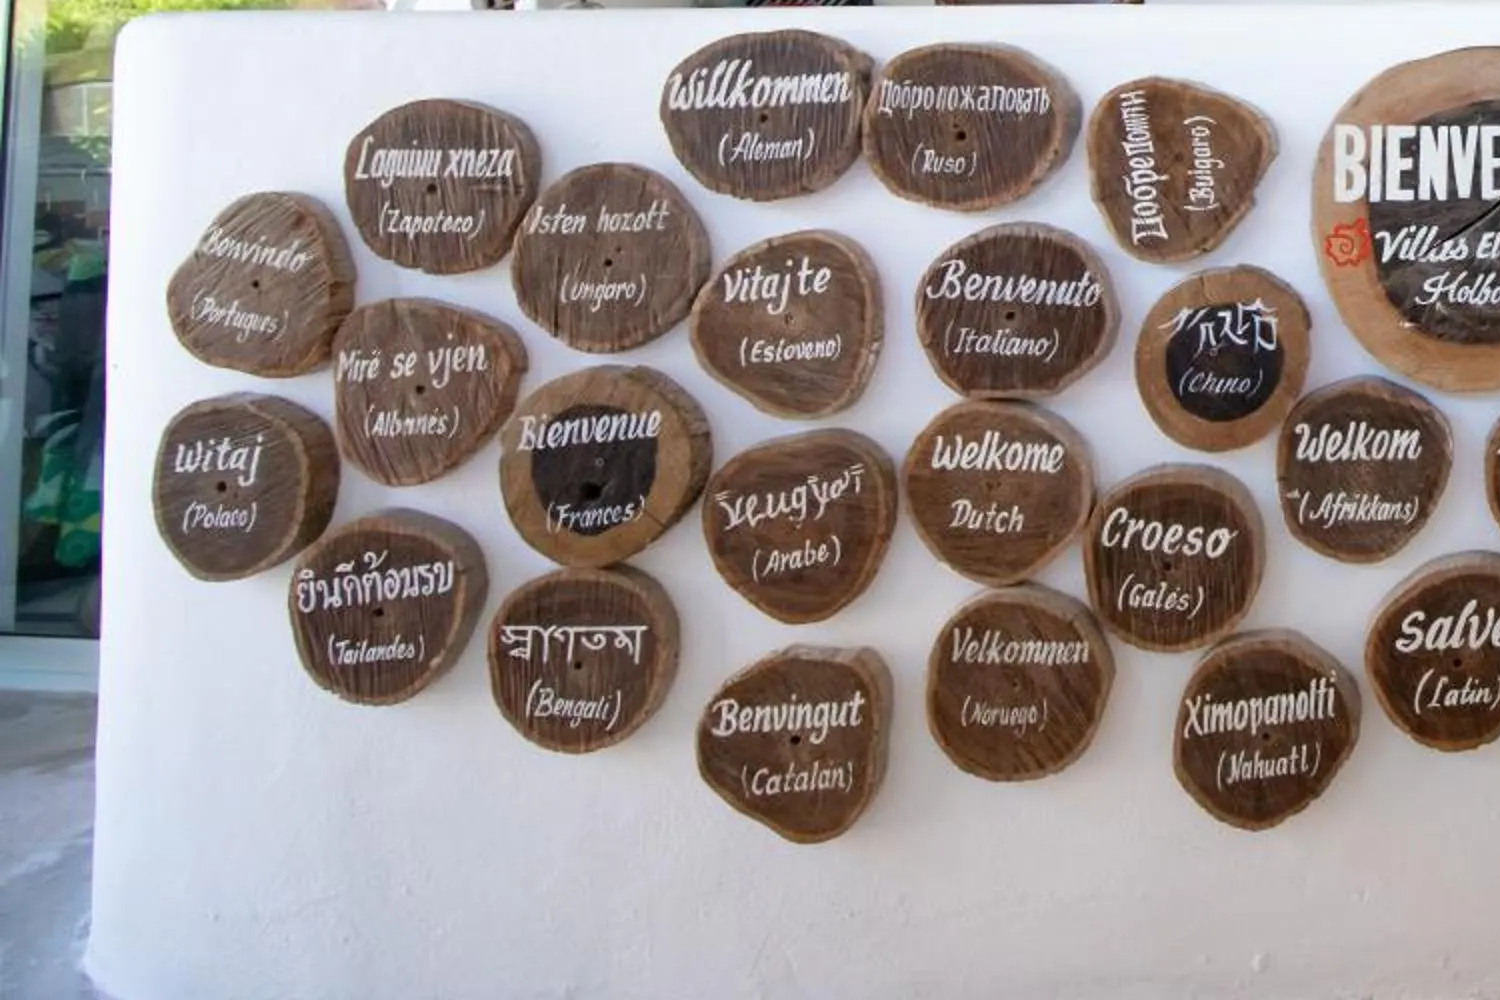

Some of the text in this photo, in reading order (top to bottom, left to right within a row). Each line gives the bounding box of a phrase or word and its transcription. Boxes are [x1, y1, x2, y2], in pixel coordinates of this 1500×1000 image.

[669, 60, 852, 111] Willkommen
[911, 143, 978, 177] (Ruso)
[380, 203, 485, 241] (Zapoteco)
[528, 205, 585, 234] Isten
[1376, 224, 1468, 263] Villas
[925, 260, 1102, 307] Benvenuto
[391, 350, 417, 378] se
[428, 332, 488, 389] vjen
[944, 324, 1060, 363] (Italiano)
[1179, 367, 1263, 398] (Chino)
[518, 410, 662, 451] Bienvenue
[1294, 422, 1422, 462] Welkom
[931, 431, 1065, 473] Welkome
[183, 502, 257, 533] (Polaco)
[546, 495, 645, 533] (Frances)
[950, 499, 1025, 534] Dutch
[1101, 508, 1238, 559] Croeso
[752, 536, 841, 583] (Arabe)
[328, 638, 425, 665] (Tailandes)
[950, 627, 1091, 666] Velkommen
[525, 680, 621, 730] (Bengali)
[711, 690, 865, 744] Benvingut
[961, 696, 1047, 735] (Noruego)
[1217, 743, 1321, 791] (Nahuatl)
